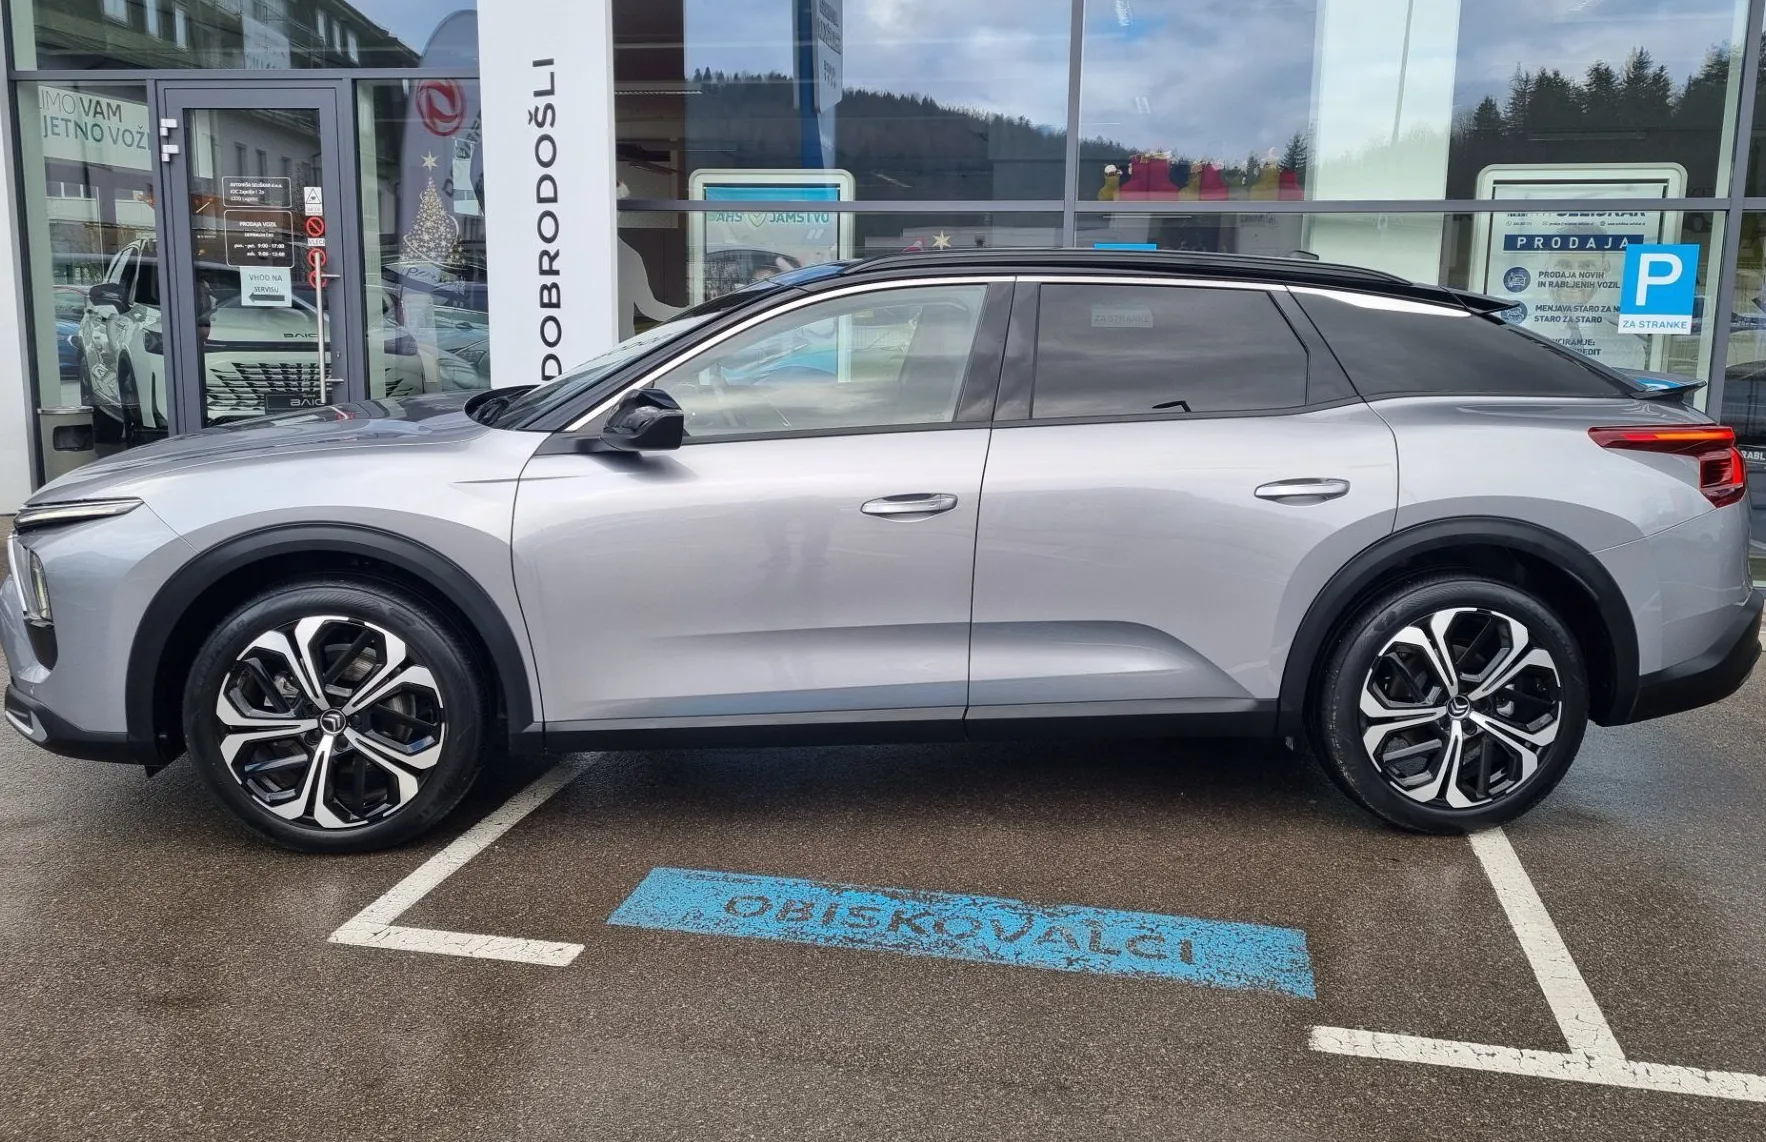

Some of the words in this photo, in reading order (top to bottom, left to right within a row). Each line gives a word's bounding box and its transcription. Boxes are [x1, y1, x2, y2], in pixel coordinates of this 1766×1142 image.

[40, 89, 76, 115] IMO
[80, 97, 122, 123] VAM
[43, 115, 104, 143] JETNO
[528, 58, 563, 382] DOBRODOŠLI
[769, 211, 829, 223] JAMSTVO
[1516, 236, 1629, 249] PRODAJA
[248, 273, 270, 281] VHOD
[1538, 271, 1577, 279] PRODAJA
[1578, 271, 1605, 279] NOVIH
[1635, 254, 1683, 306] P
[1548, 281, 1595, 289] RABLJENIH
[1596, 281, 1620, 289] VOZIL
[1535, 304, 1573, 313] MENJAVA
[1573, 305, 1599, 313] STARO
[1534, 316, 1561, 324] STARO
[1622, 320, 1636, 328] ZA
[1638, 320, 1688, 329] STRANKE
[724, 895, 1196, 965] OBISKOVALCI
